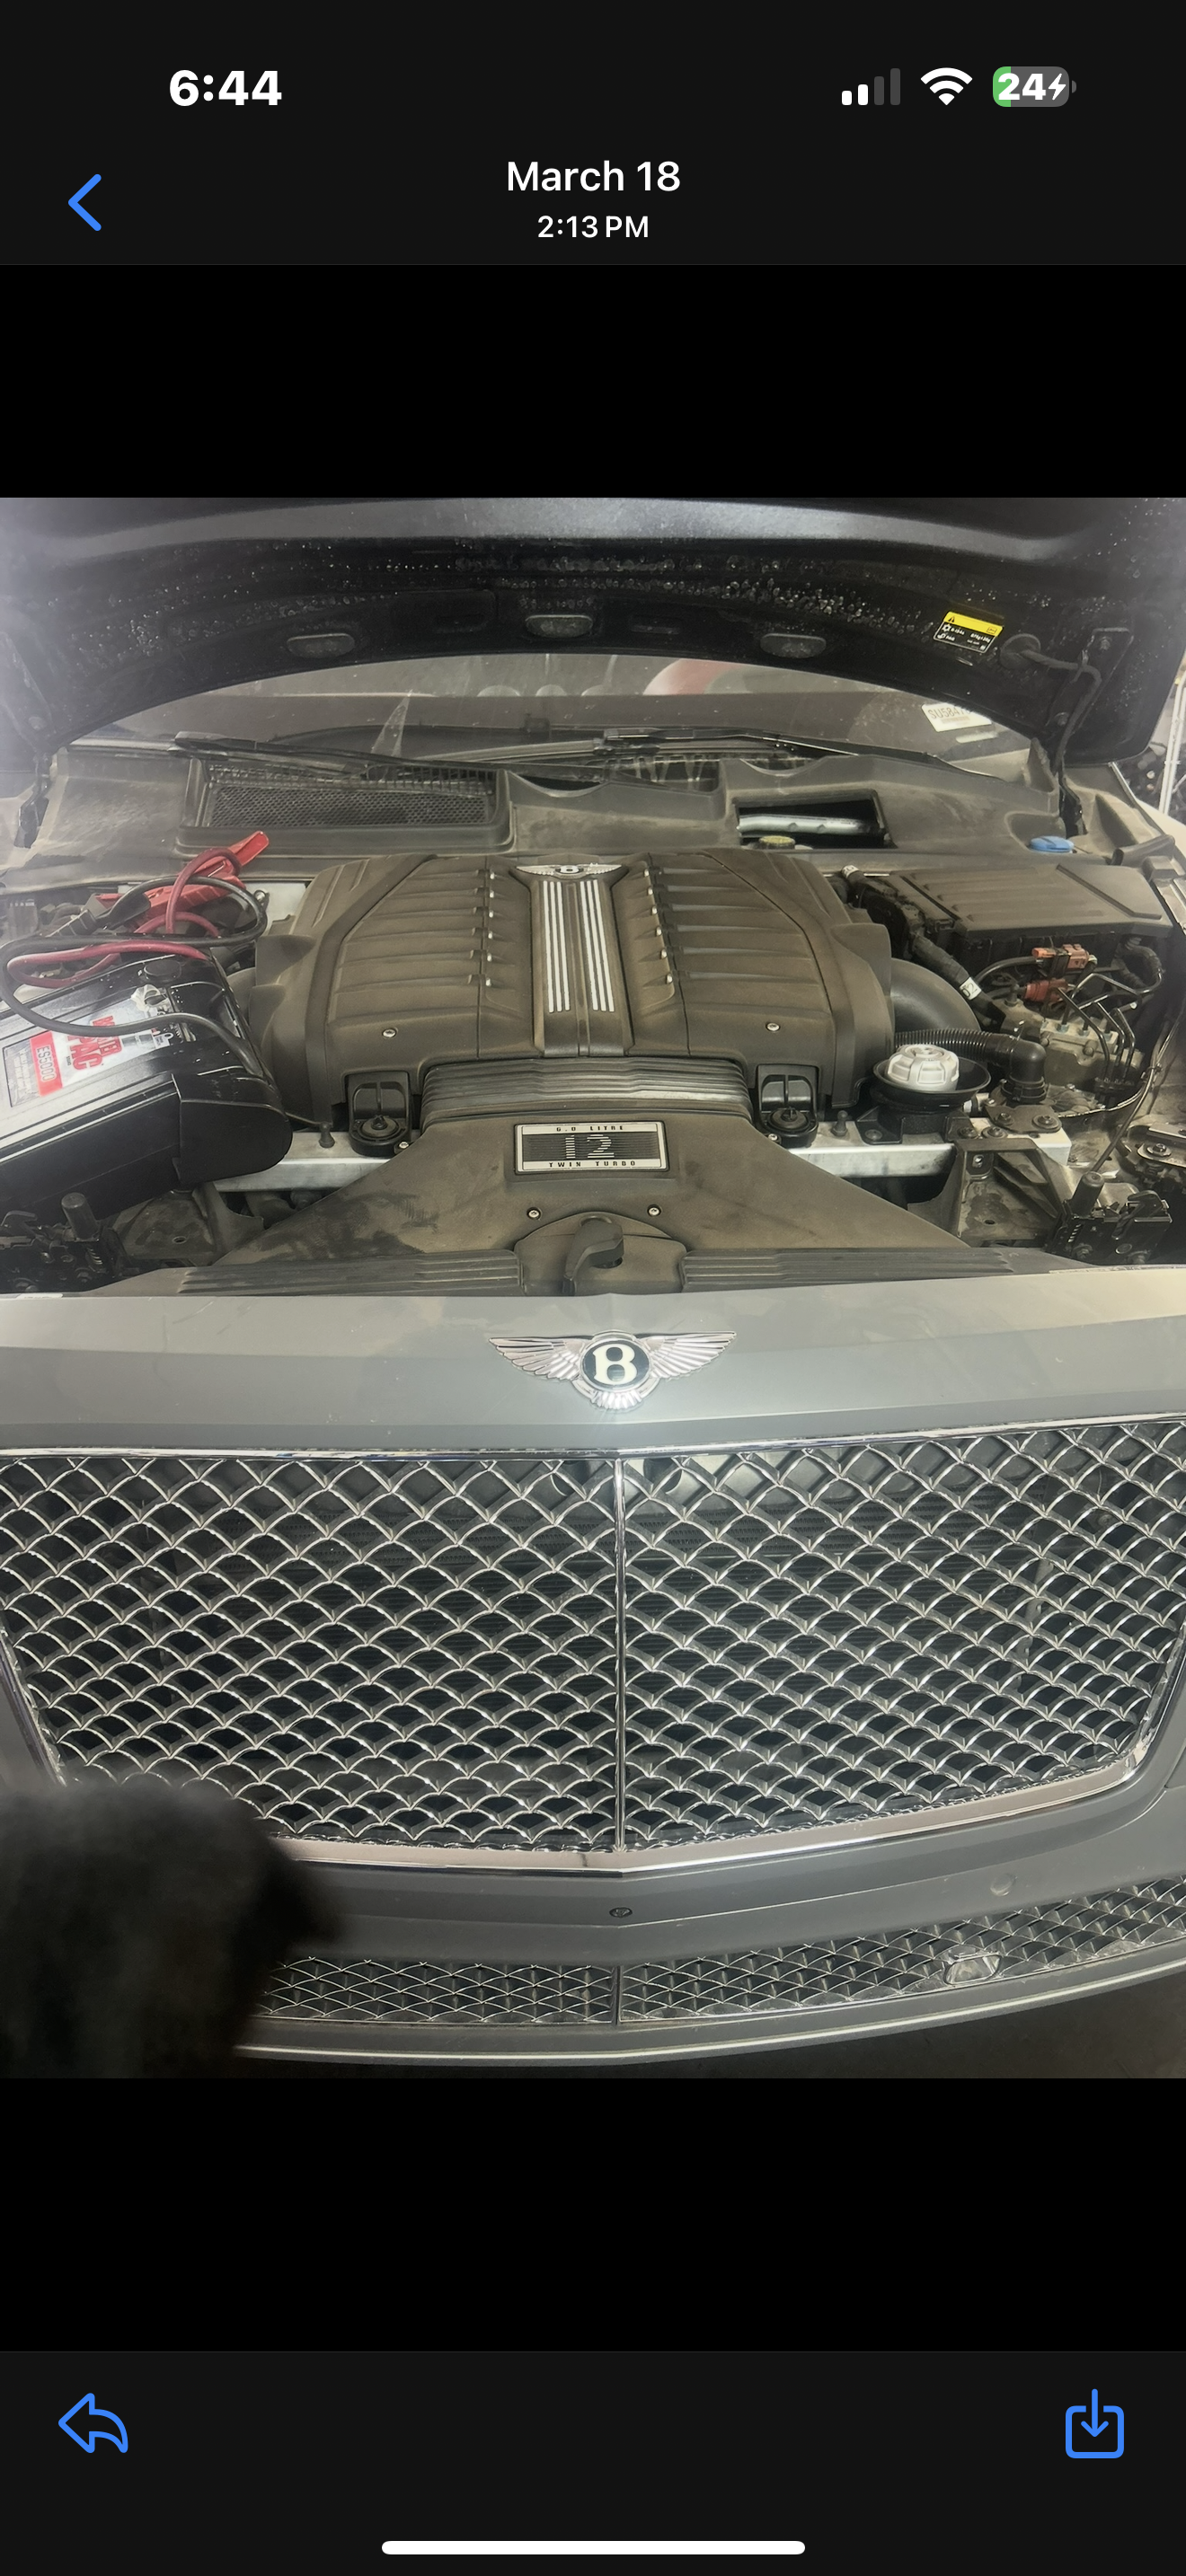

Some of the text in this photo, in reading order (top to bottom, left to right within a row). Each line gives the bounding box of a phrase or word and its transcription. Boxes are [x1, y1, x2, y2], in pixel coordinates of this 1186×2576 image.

[36, 1045, 56, 1081] ES5000
[564, 1134, 615, 1160] 12
[592, 1345, 638, 1386] B
